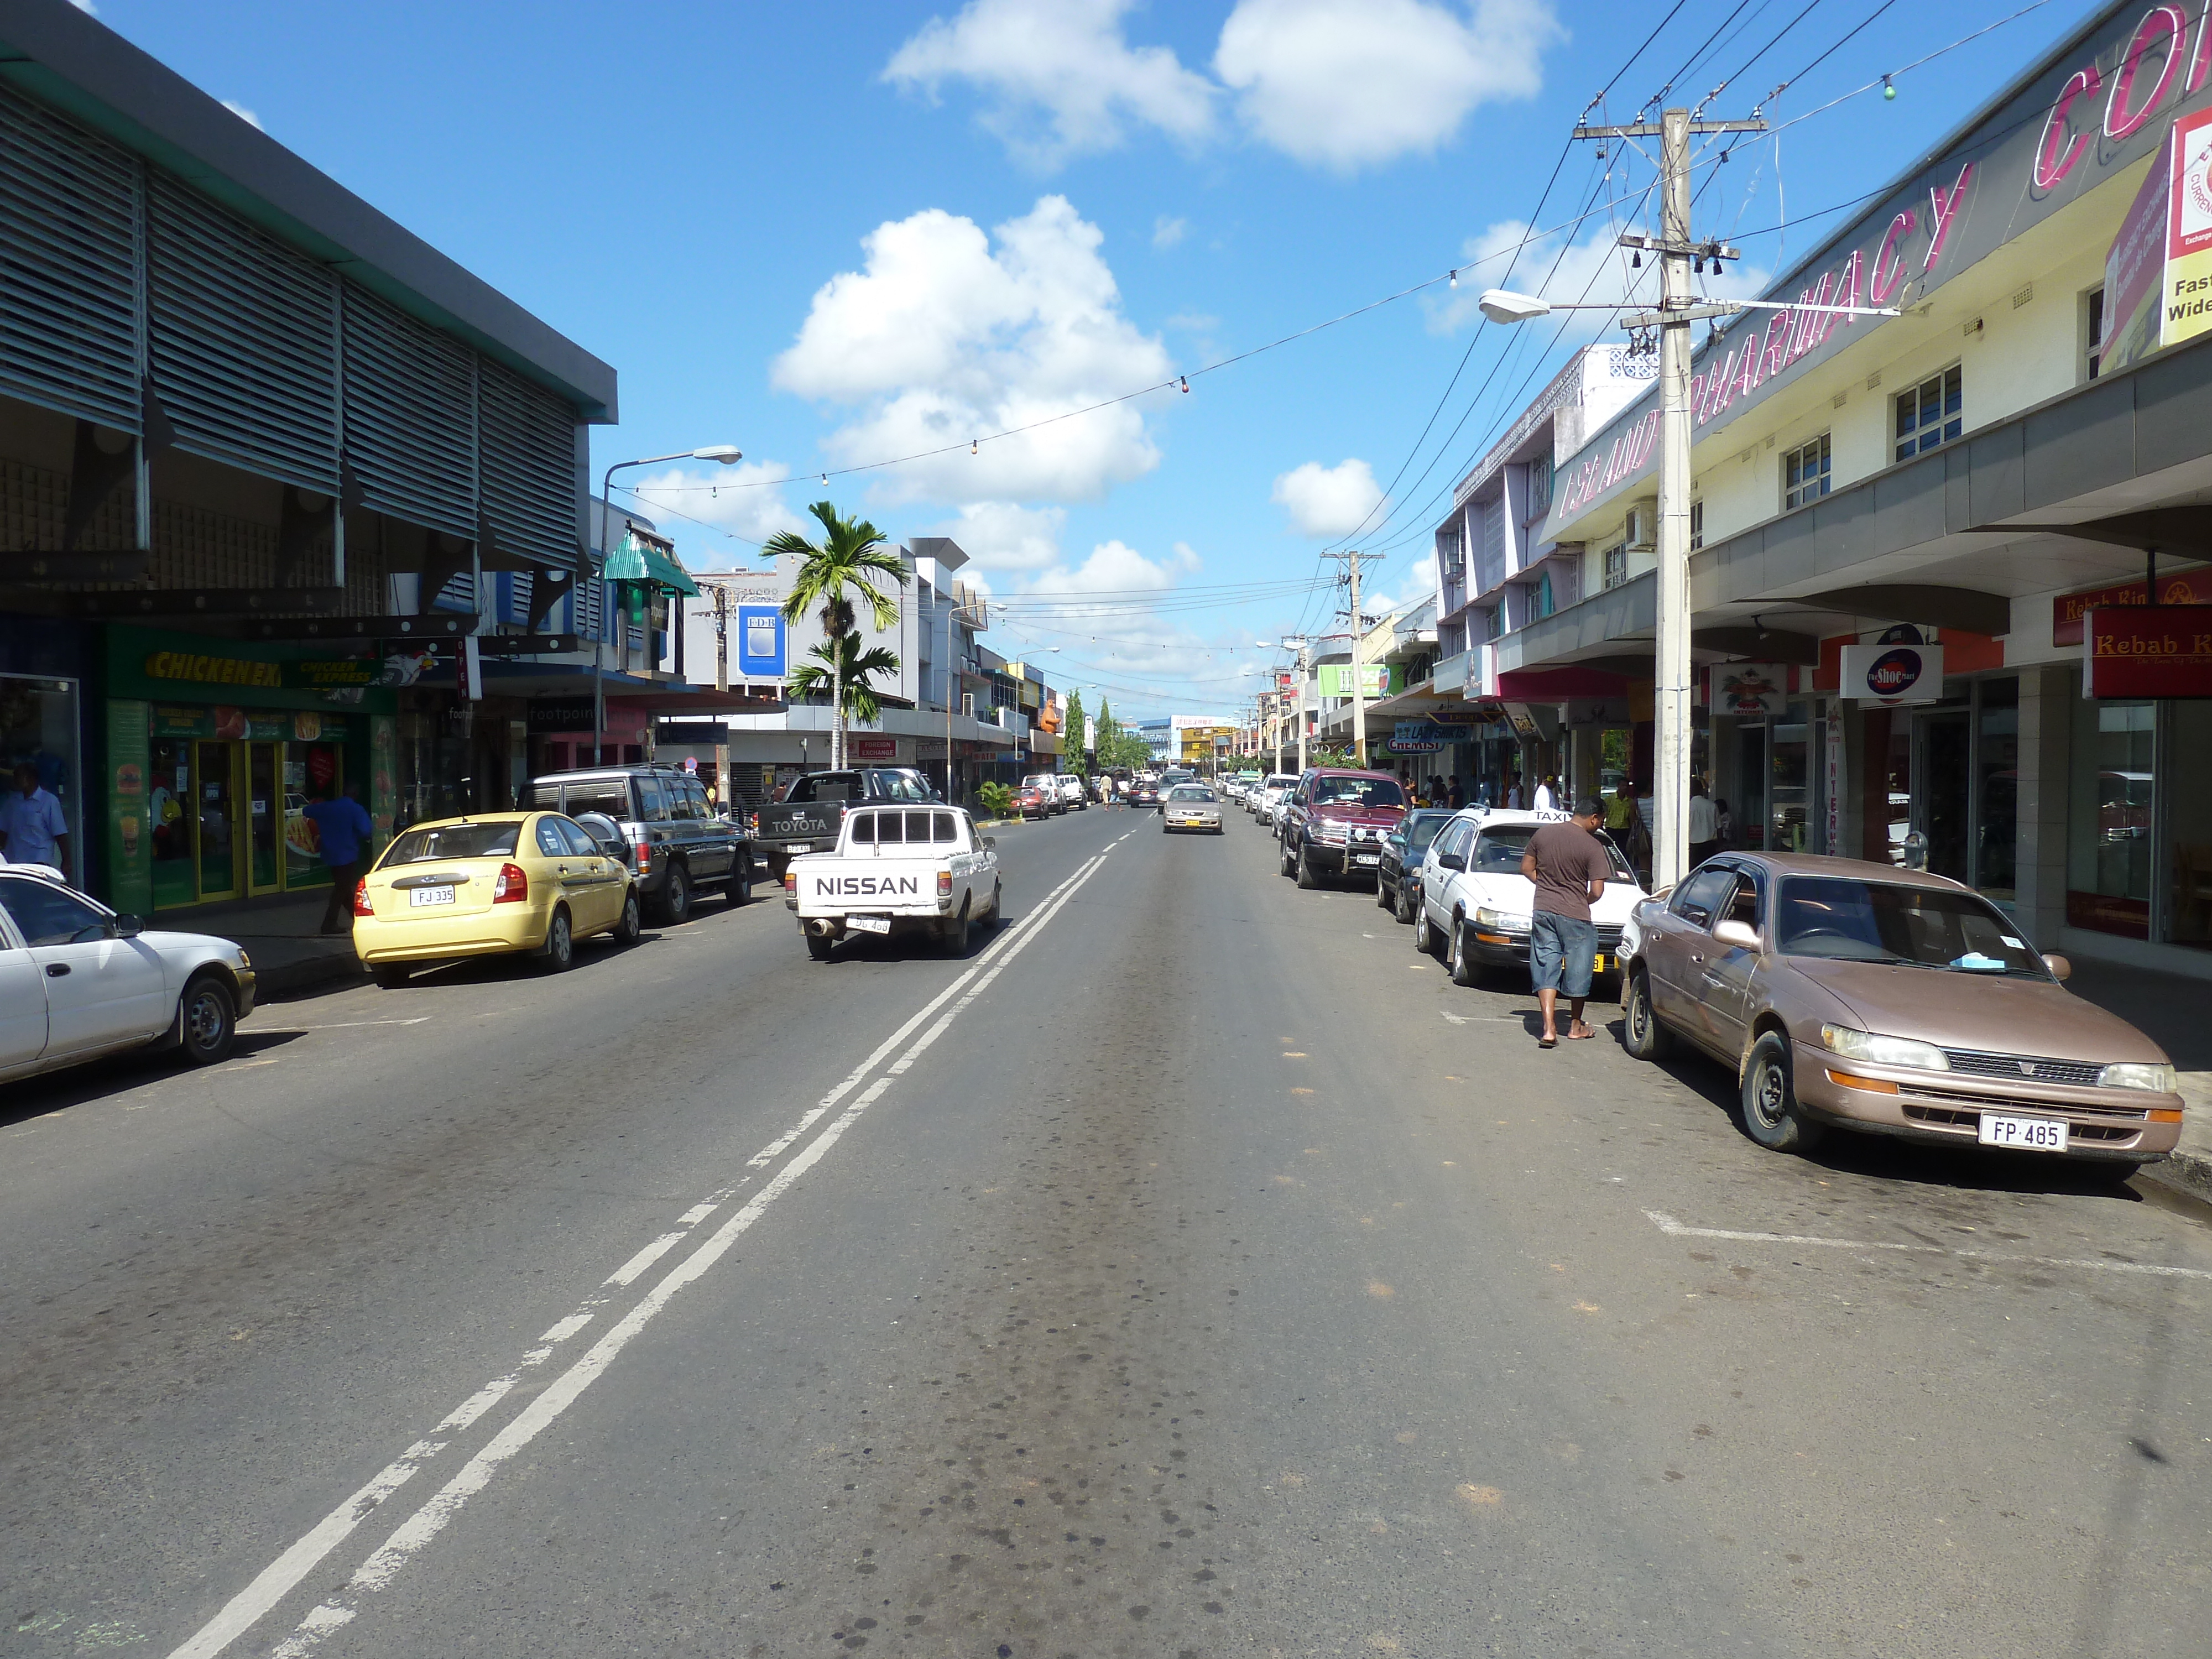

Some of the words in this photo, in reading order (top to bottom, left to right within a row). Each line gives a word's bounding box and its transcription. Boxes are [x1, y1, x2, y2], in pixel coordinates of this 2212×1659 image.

[2191, 173, 2212, 215] CURREN
[2095, 634, 2178, 655] Kebab
[154, 651, 249, 684] CHICKEN
[253, 662, 281, 687] EX
[300, 662, 358, 672] CHICKEN
[457, 640, 467, 698] OPEN
[312, 672, 371, 682] EXPRESS
[1877, 668, 1902, 684] Shoe
[529, 707, 594, 724] footpoin
[1411, 726, 1433, 739] LAZY
[1434, 726, 1467, 739] SHIRTS
[1390, 740, 1439, 749] CHEMIST
[1533, 811, 1566, 822] TAXI
[772, 819, 827, 832] TOYOTA
[817, 877, 917, 895] NISSAN
[419, 892, 432, 902] FJ
[436, 890, 453, 901] 335
[1994, 1121, 2016, 1141] FP
[2024, 1125, 2058, 1146] 485
